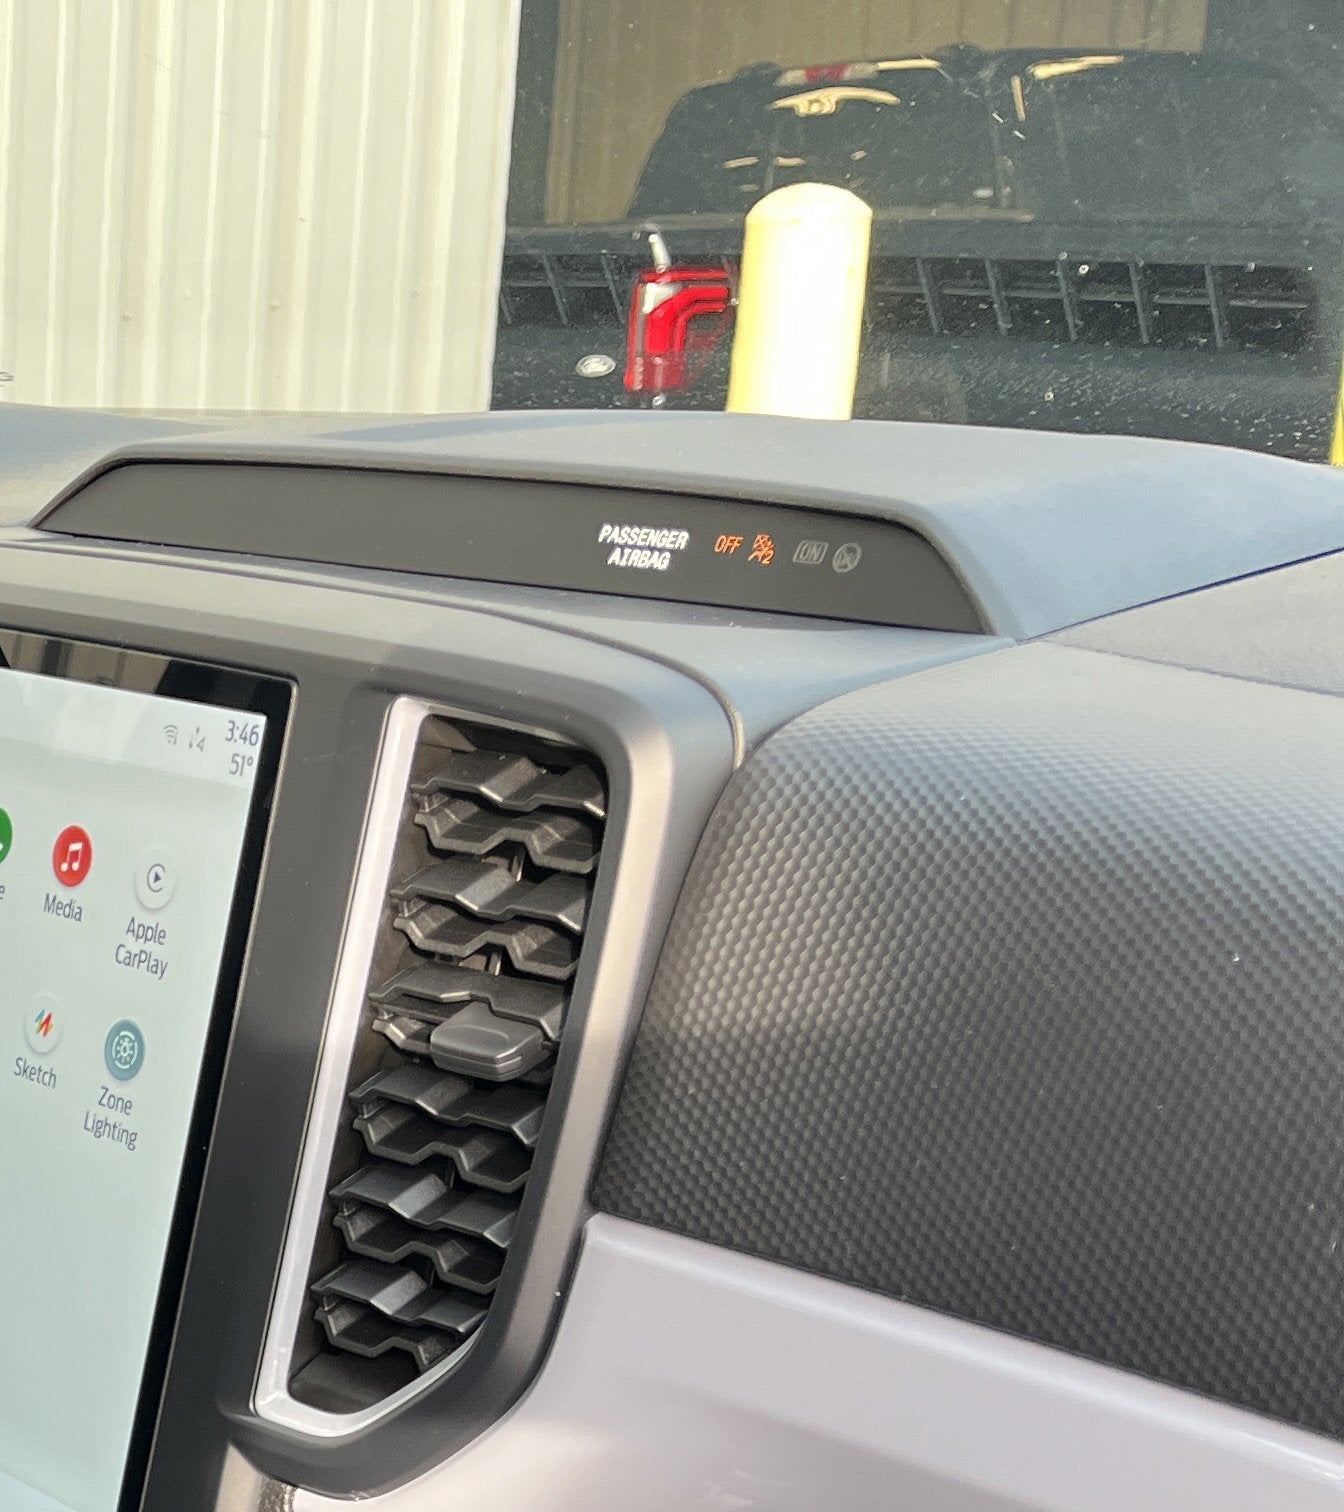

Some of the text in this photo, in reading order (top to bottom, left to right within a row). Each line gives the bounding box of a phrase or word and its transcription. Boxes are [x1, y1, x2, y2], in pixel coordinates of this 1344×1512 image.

[598, 523, 689, 550] PASSENGER
[714, 535, 745, 554] OFF
[607, 547, 672, 571] AIRBAG
[225, 720, 259, 747] 3:46
[43, 893, 83, 922] Media
[126, 916, 167, 946] Apple
[114, 944, 169, 980] CarPlay
[14, 1056, 57, 1089] Sketch
[98, 1086, 133, 1116] Zone
[83, 1111, 138, 1151] Lighting
